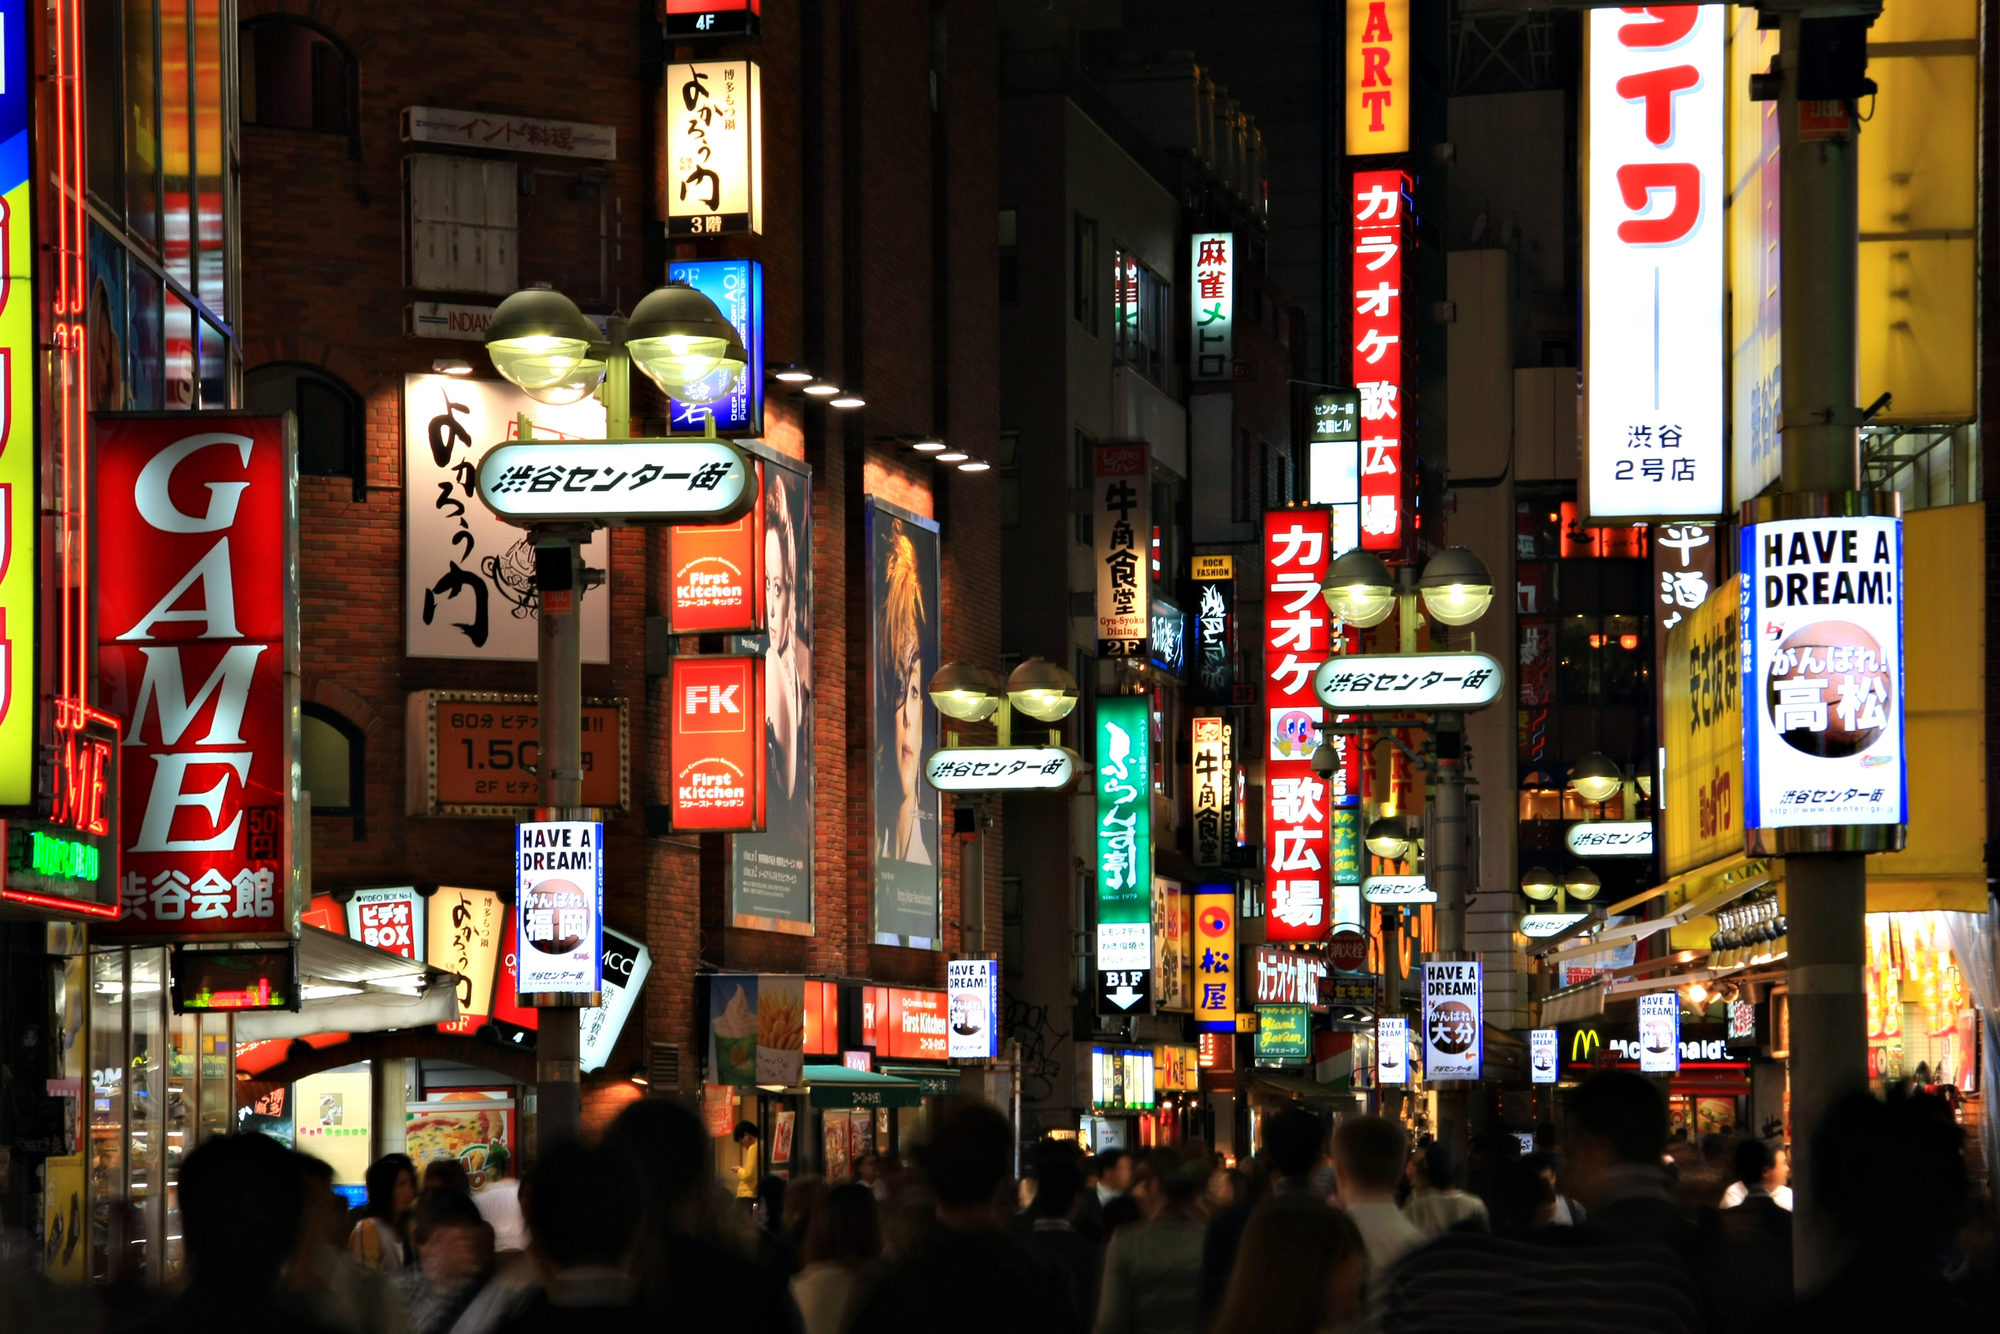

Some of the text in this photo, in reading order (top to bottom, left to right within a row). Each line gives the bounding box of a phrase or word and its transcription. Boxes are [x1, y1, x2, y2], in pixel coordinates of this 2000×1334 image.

[696, 14, 715, 30] 4F
[690, 215, 722, 234] 3階
[1196, 238, 1227, 377] 麻雀メトロ
[1314, 403, 1355, 416] センター街
[1316, 418, 1352, 434] 太田ビル
[1627, 424, 1683, 448] 渋谷
[491, 462, 734, 494] 渋谷センター街
[1614, 457, 1696, 482] 2号店
[1105, 479, 1139, 616] 牛角食堂
[1763, 529, 1891, 568] HAVE A
[1197, 568, 1230, 577] FASHION
[1202, 559, 1224, 567] ROCK
[690, 571, 729, 585] First
[677, 584, 742, 599] Kitchen
[1764, 571, 1893, 609] DREAM!
[1100, 617, 1145, 627] Gyu-Syoku
[1106, 627, 1139, 636] Dining
[114, 432, 268, 853] GAME
[1106, 640, 1140, 655] 2F
[1323, 669, 1494, 693] 渋谷センター街
[685, 684, 740, 714] FK
[1772, 675, 1889, 735] 高松
[931, 758, 1066, 778] 渋谷センター街
[692, 772, 732, 786] First
[679, 786, 744, 799] Kitchen
[1779, 787, 1886, 805] 渋谷センター街
[1194, 749, 1220, 864] 牛角食堂
[523, 828, 591, 849] HAVE A
[523, 851, 592, 871] DREAM!
[362, 904, 408, 927] ビデオ
[525, 909, 588, 942] 福岡
[364, 925, 411, 947] BOX
[1330, 942, 1365, 959] 消火栓
[949, 964, 987, 976] HAVE A
[1105, 970, 1143, 987] B1F
[1199, 947, 1230, 1011] 松屋
[1427, 966, 1476, 980] HAVE A
[949, 977, 988, 989] DREAM!
[1427, 982, 1477, 996] DREAM!
[1641, 996, 1674, 1006] HAVE A
[1641, 1006, 1674, 1016] DREAM!
[902, 1010, 946, 1035] First Kitchen
[1431, 1023, 1475, 1045] 大分
